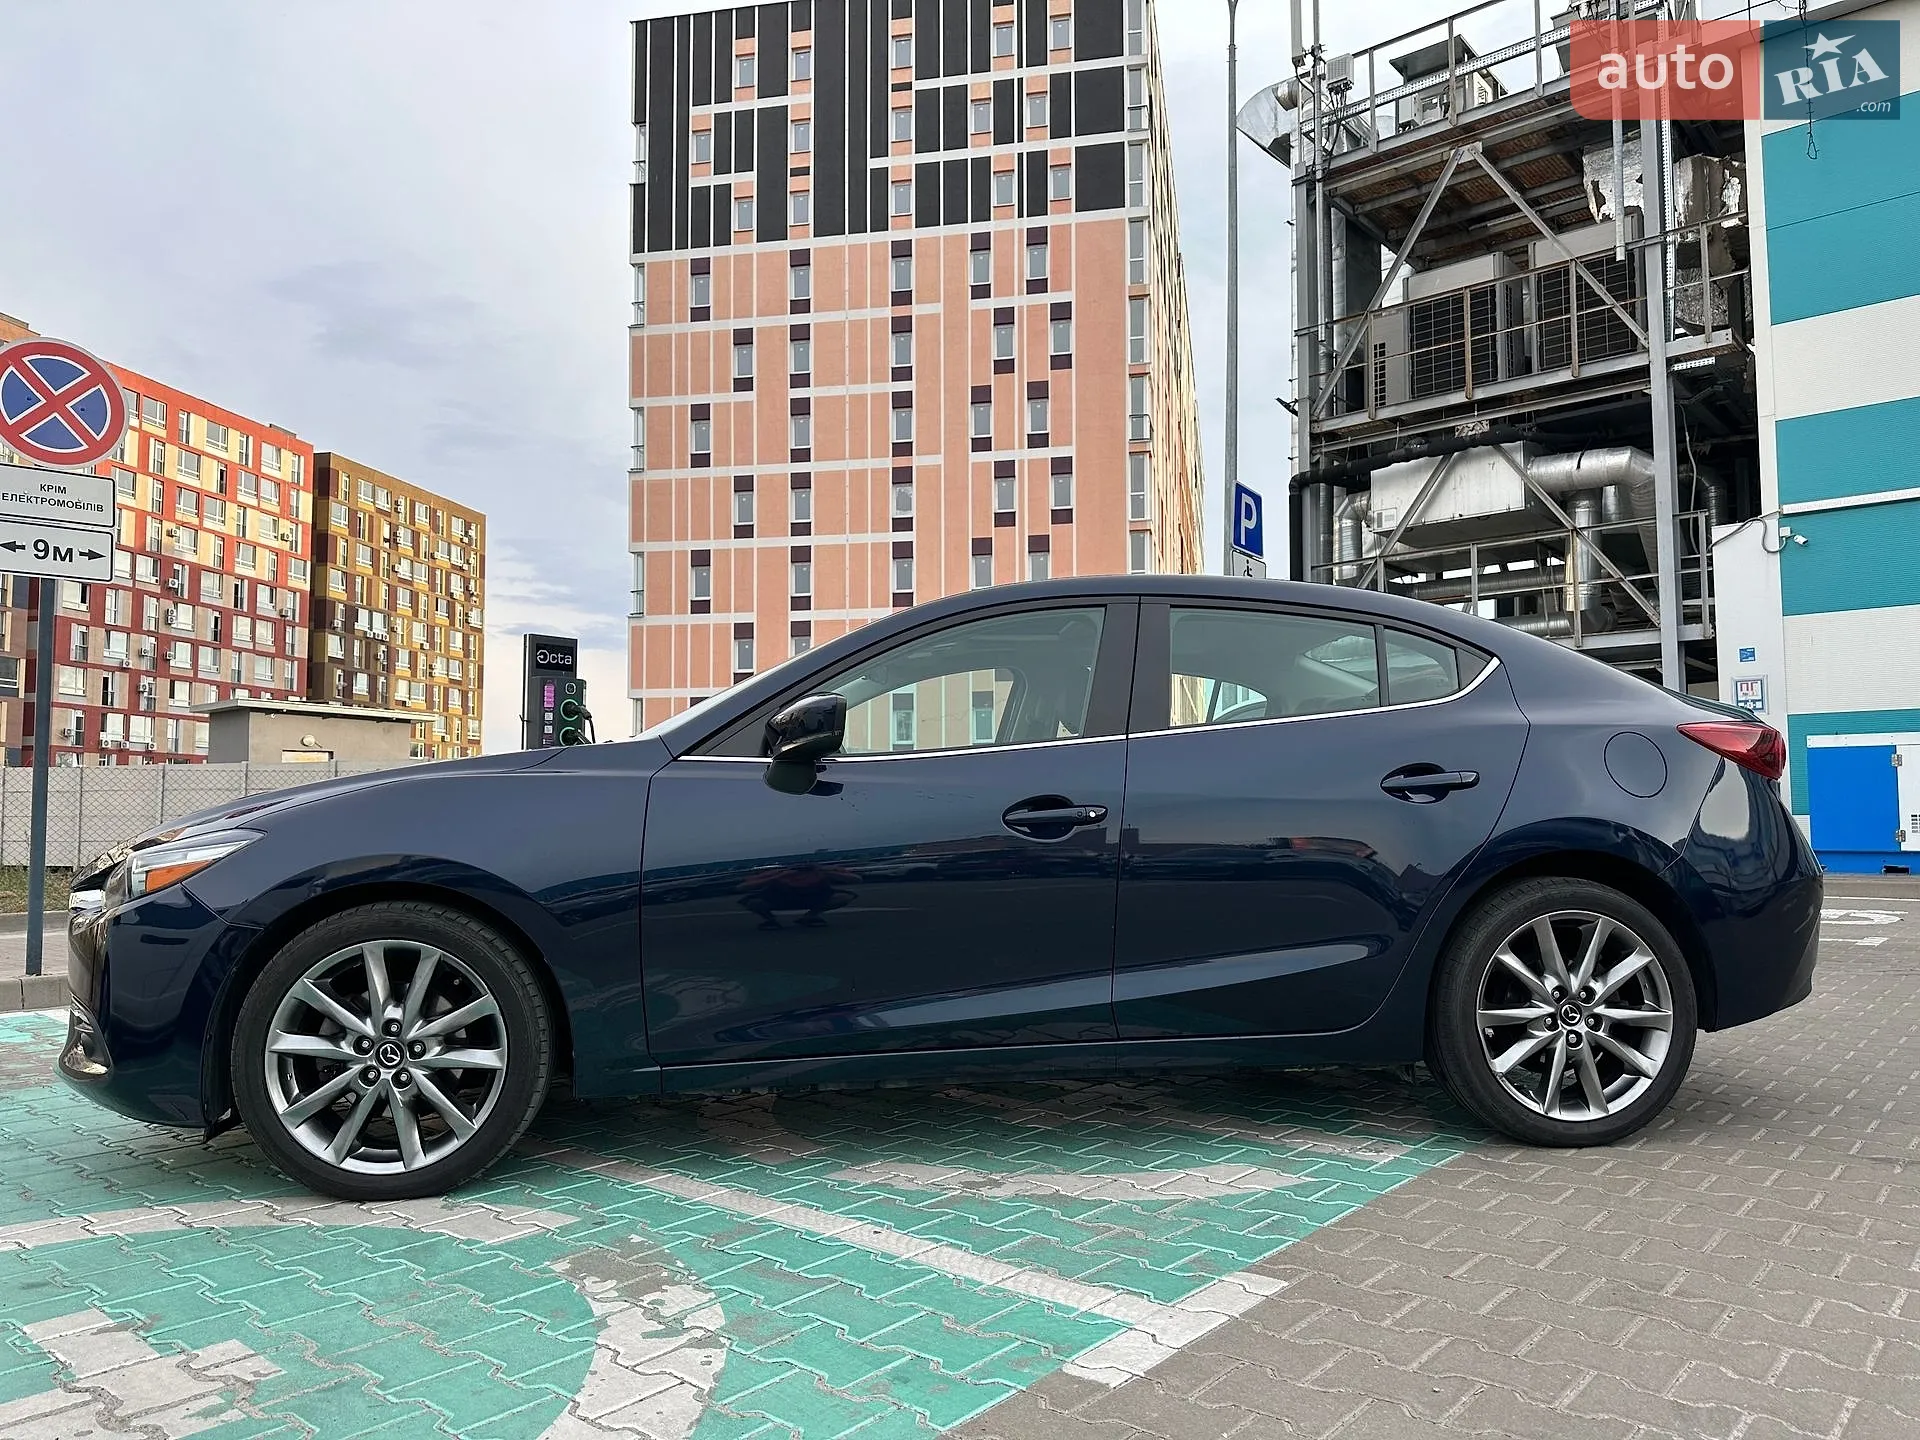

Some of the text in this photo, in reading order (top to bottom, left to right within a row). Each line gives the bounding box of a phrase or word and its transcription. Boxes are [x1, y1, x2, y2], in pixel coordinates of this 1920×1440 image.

[39, 483, 67, 494] КРІМ
[1, 492, 104, 512] ЕЛЕКТРОМОБІЛІВ
[1240, 492, 1257, 546] P
